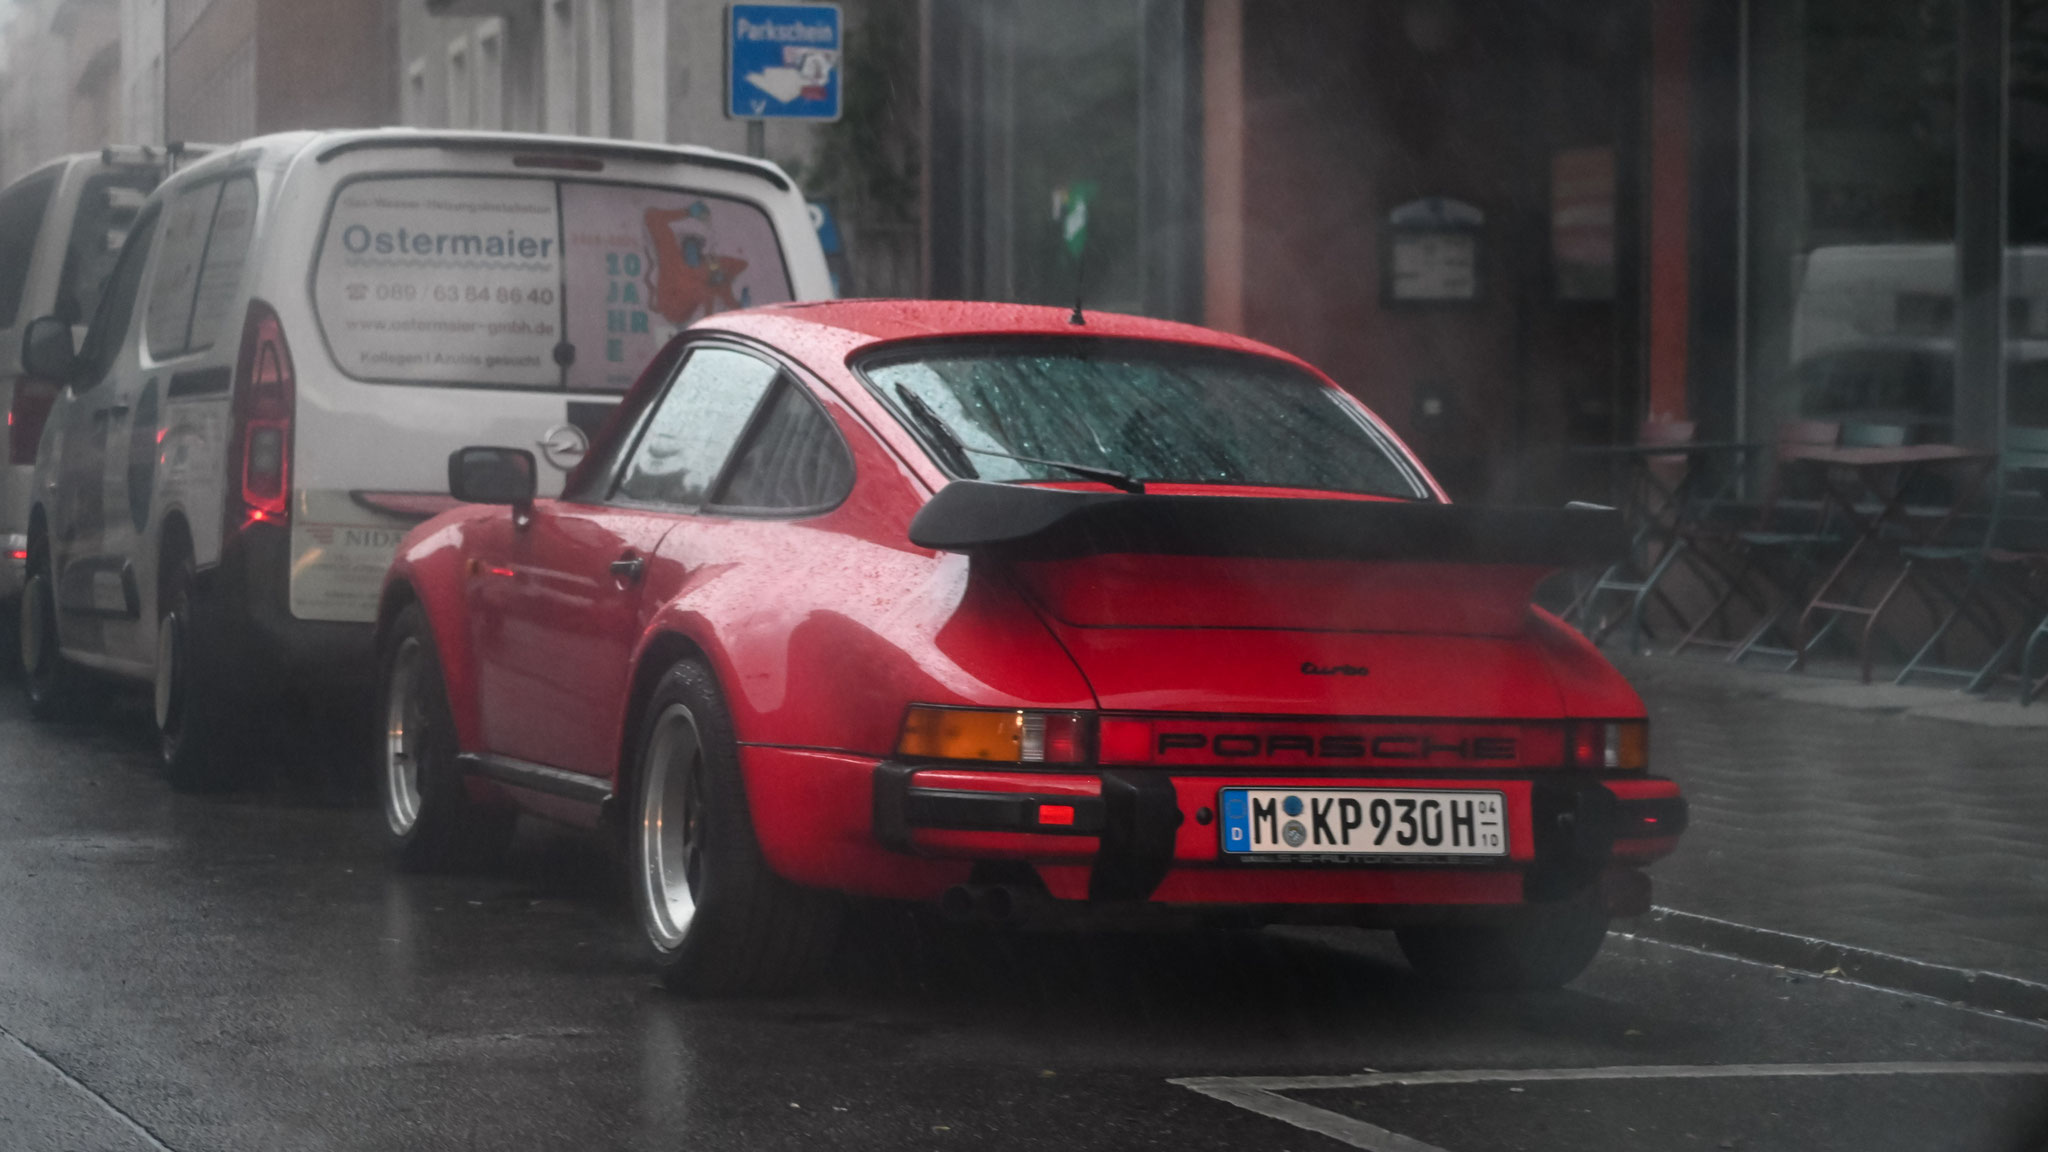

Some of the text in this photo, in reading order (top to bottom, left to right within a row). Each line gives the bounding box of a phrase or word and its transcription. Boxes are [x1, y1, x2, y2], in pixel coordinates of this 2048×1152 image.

[737, 17, 833, 42] Parkschein
[342, 223, 553, 258] Ostermaier
[606, 252, 641, 277] 10
[375, 284, 418, 302] 089
[433, 284, 460, 304] 63
[464, 286, 491, 304] 84
[496, 286, 523, 305] 86
[526, 288, 554, 306] 40
[345, 319, 554, 337] www.ostermaier-gmbh.de
[485, 354, 541, 368] gesucht
[1158, 733, 1517, 760] PORSCHE
[1231, 827, 1244, 841] D
[1252, 797, 1279, 845] M
[1481, 833, 1499, 847] 10
